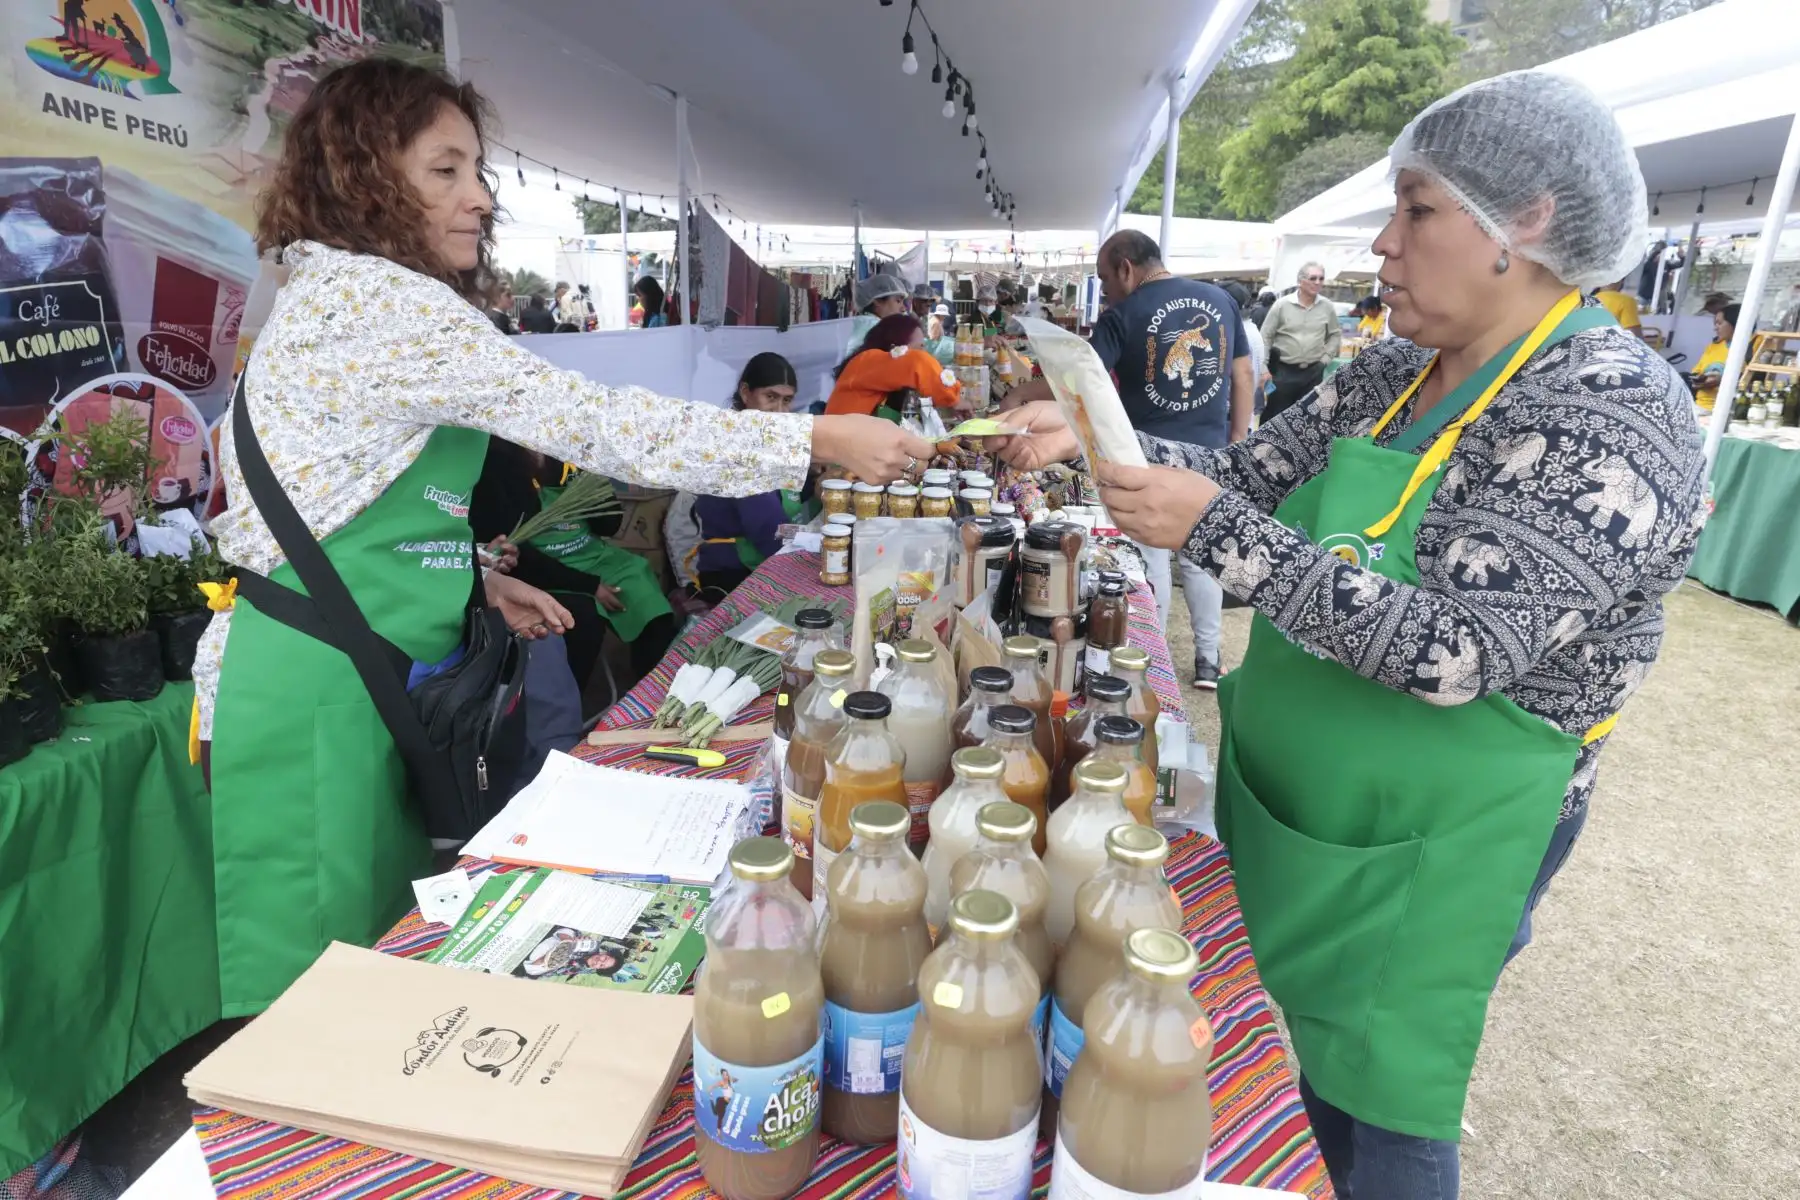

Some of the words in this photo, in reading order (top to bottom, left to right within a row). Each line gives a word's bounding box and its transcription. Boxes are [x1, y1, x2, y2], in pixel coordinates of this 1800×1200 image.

[43, 92, 118, 131] ANPE
[126, 114, 188, 148] PERÚ
[18, 294, 60, 327] Café
[1147, 309, 1166, 334] DOO
[1166, 298, 1222, 322] AUSTRALIA
[0, 340, 16, 364] L
[16, 325, 100, 359] COLONO
[159, 321, 178, 332] POLVO
[178, 326, 186, 334] DE
[186, 331, 205, 343] CACAO
[146, 336, 211, 382] Felicidad
[1145, 383, 1167, 407] ONLY
[1167, 401, 1189, 411] FOR
[1192, 376, 1223, 409] RIDERS
[424, 484, 460, 504] Frutos
[393, 541, 457, 553] ALIMENTOS
[422, 557, 453, 569] PARA
[453, 557, 464, 569] EL
[402, 1040, 438, 1076] Cóndor
[434, 1006, 468, 1040] Andino
[764, 1090, 820, 1133] chofa
